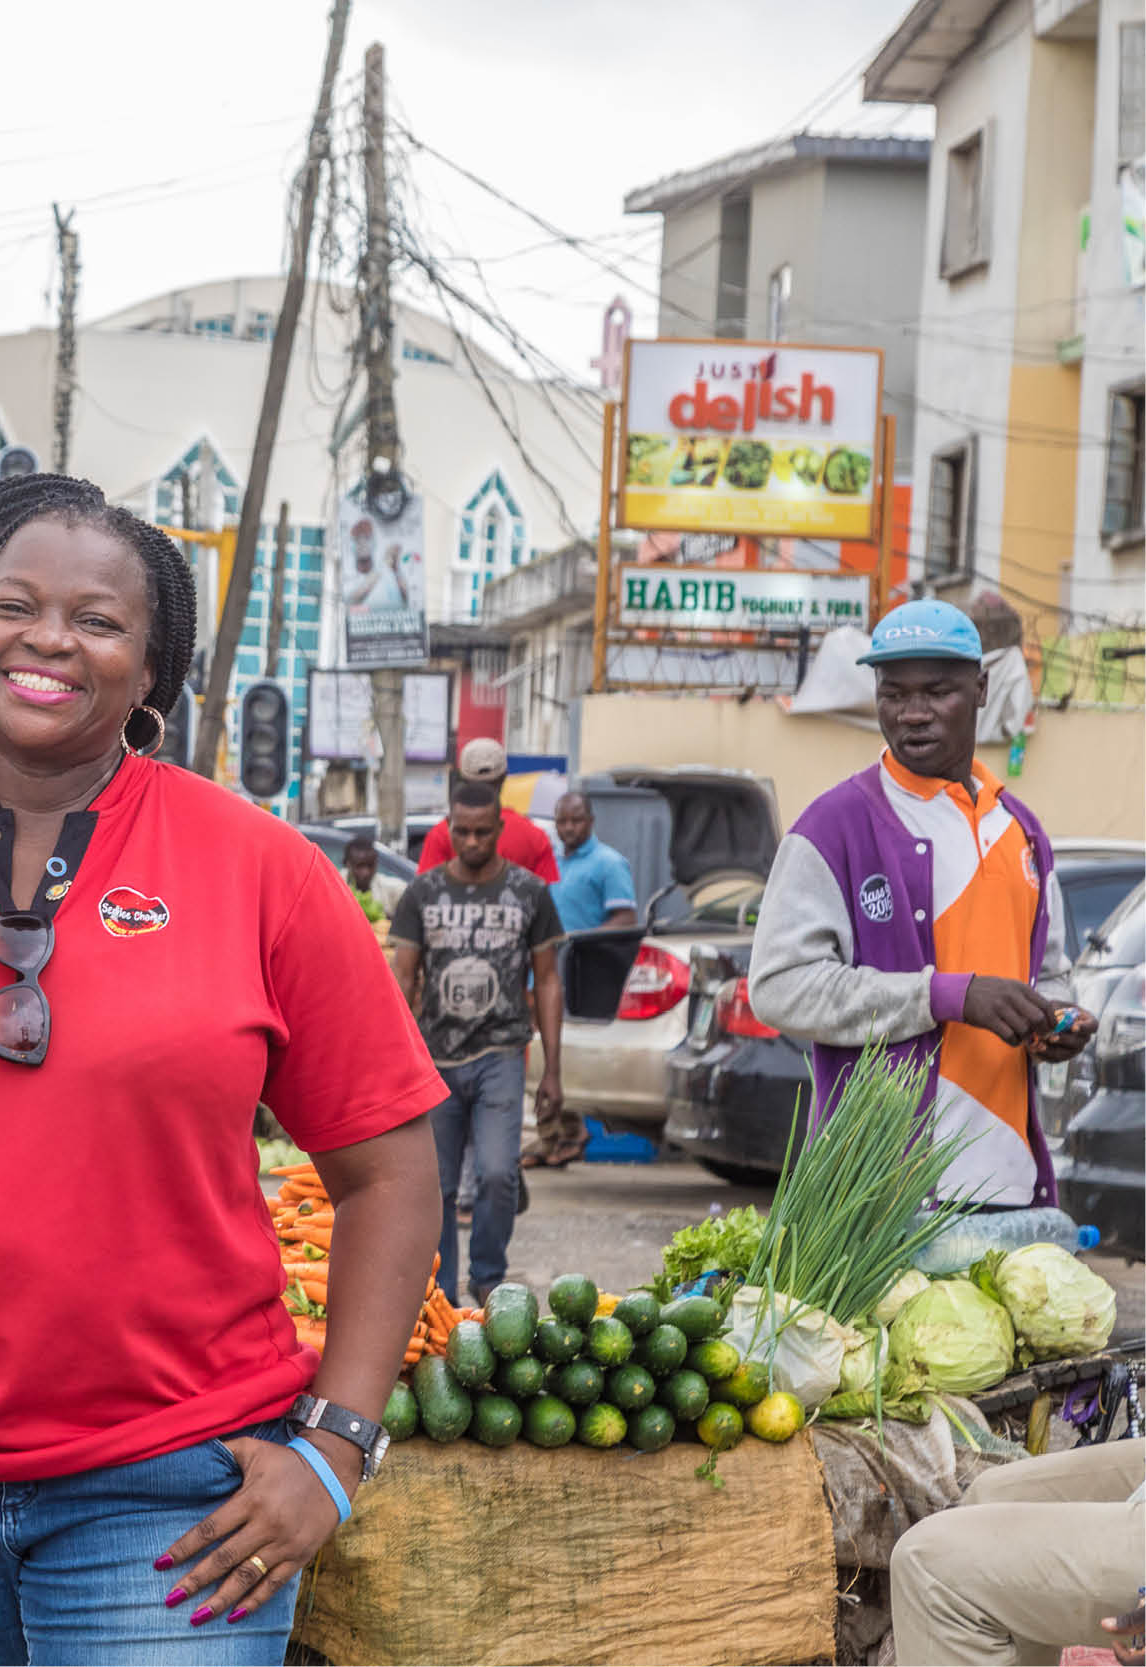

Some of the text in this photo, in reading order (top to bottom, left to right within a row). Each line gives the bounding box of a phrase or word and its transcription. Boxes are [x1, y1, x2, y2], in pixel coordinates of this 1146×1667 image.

[696, 362, 761, 379] JUST
[669, 369, 835, 432] delish
[625, 577, 736, 612] HABIB
[422, 904, 523, 930] SUPER
